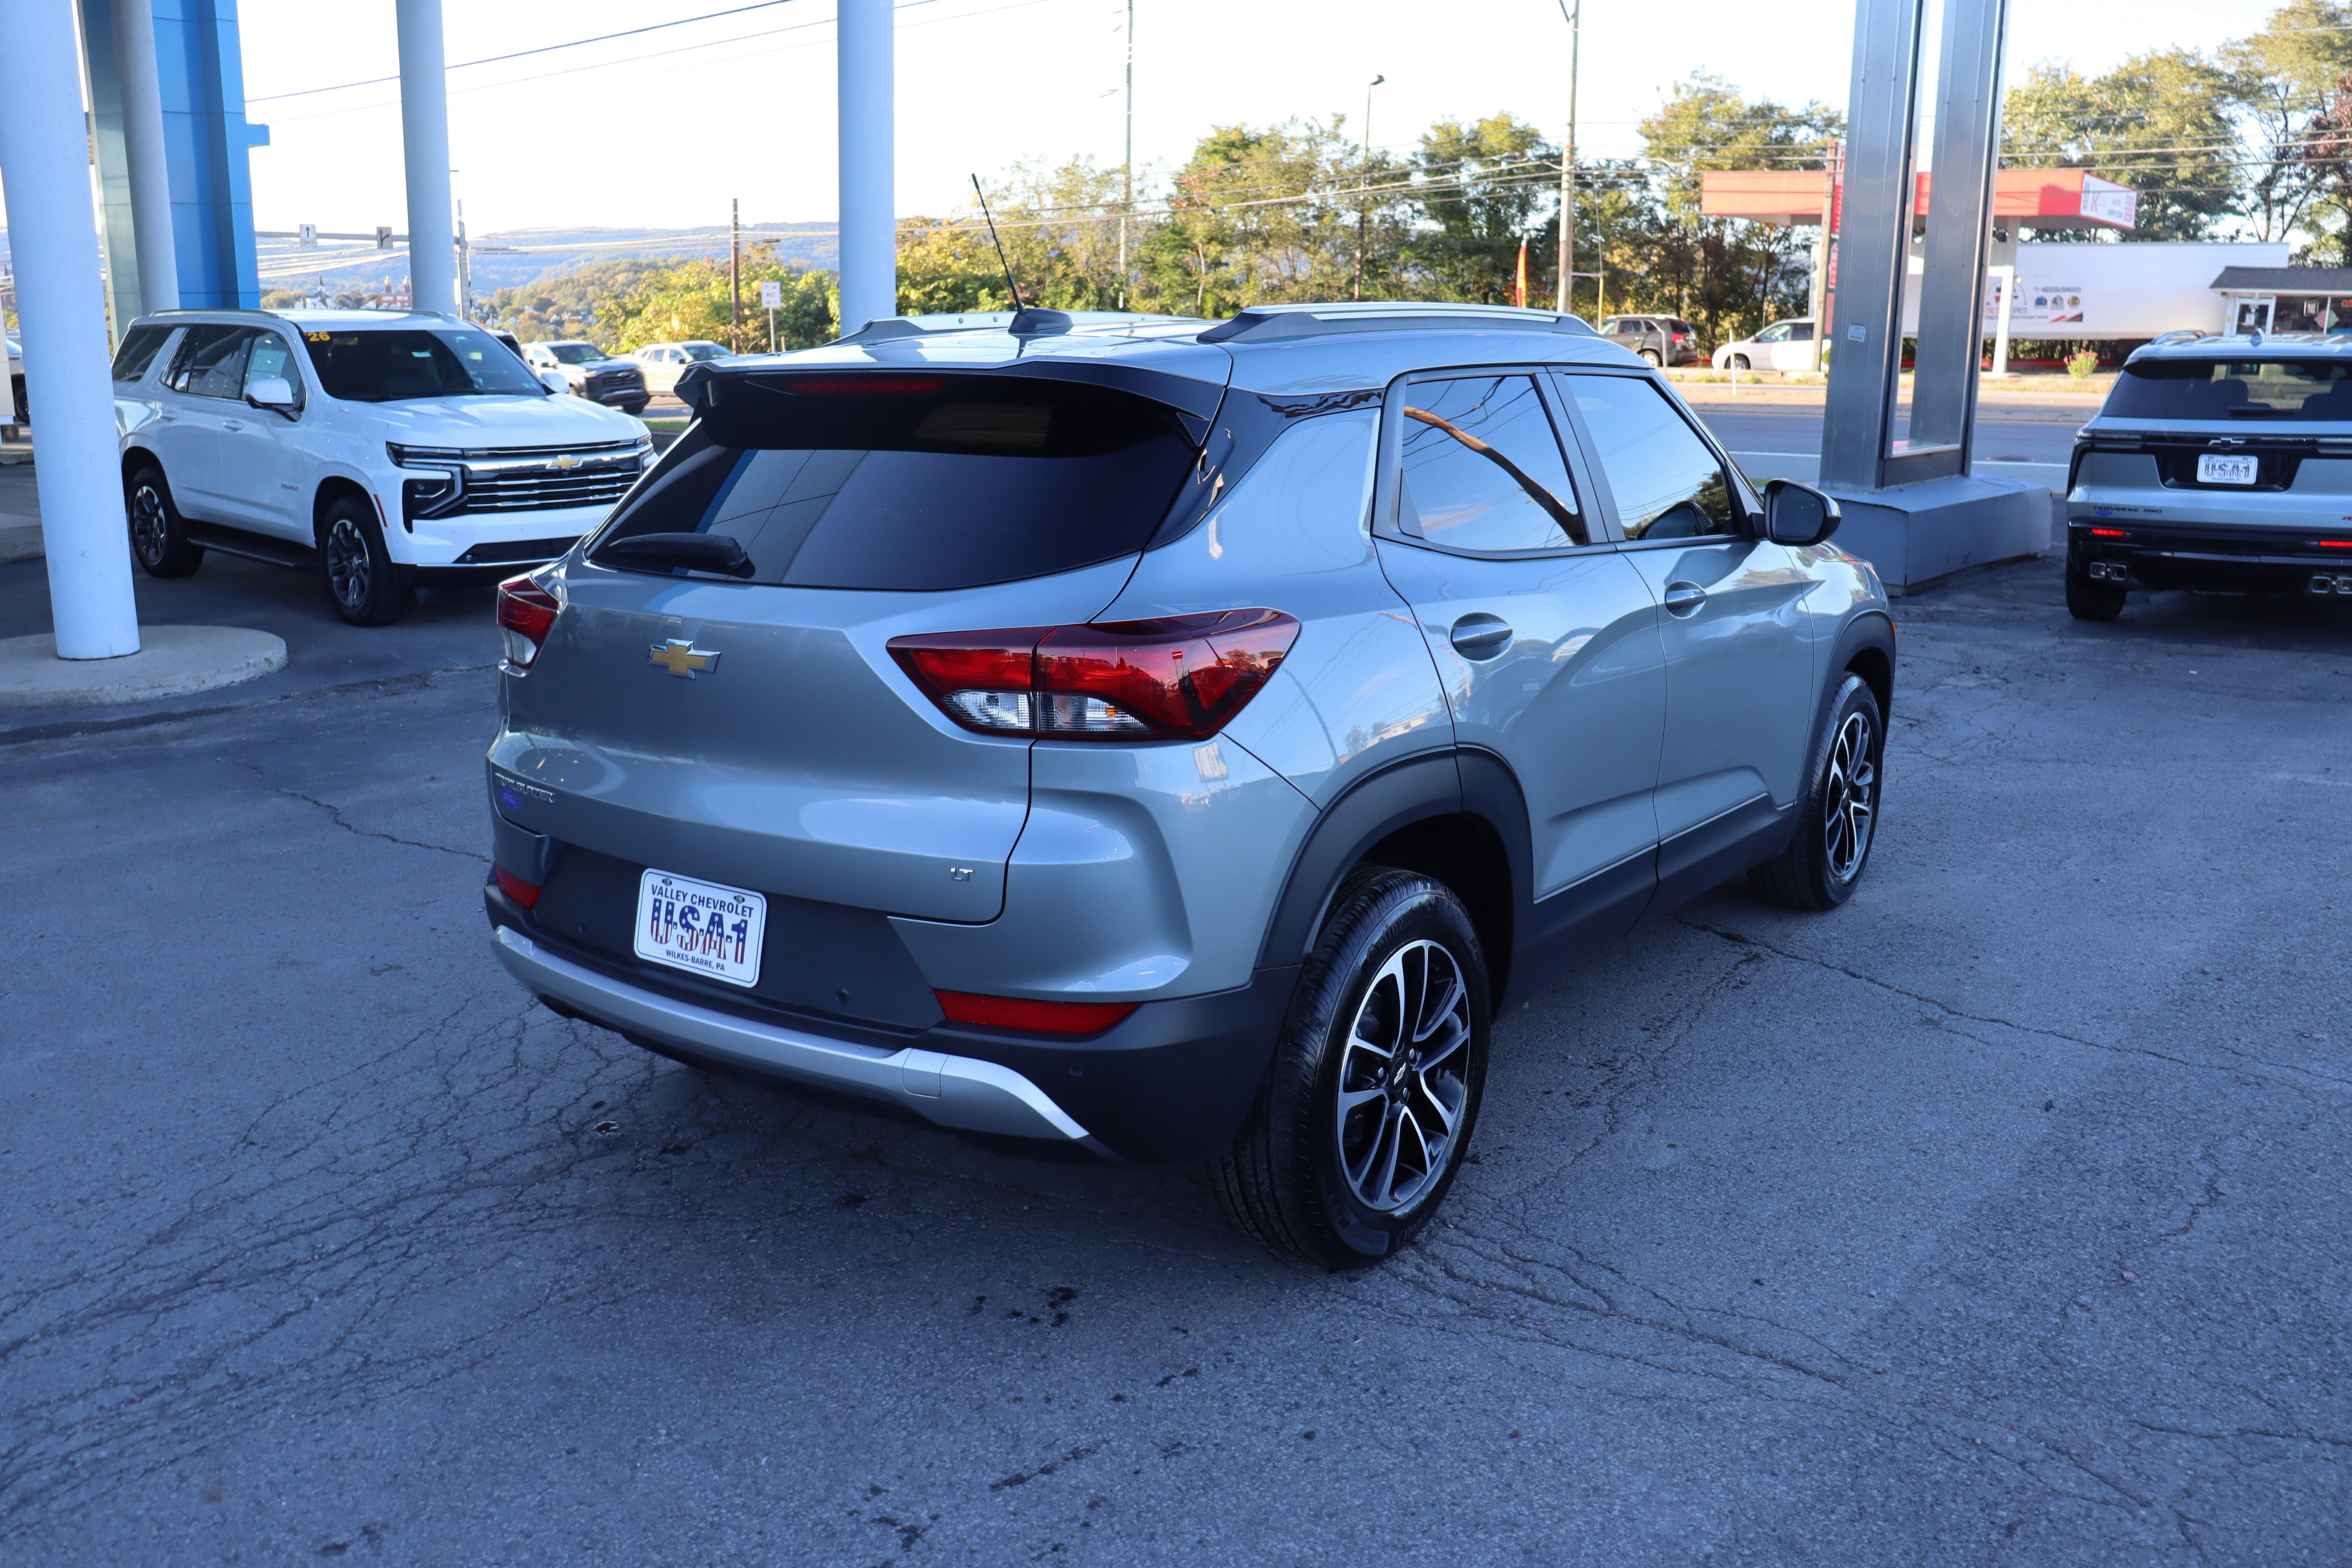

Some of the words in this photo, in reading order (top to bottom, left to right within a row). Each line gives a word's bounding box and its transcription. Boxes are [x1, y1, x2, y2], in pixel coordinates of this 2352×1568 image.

[950, 867, 974, 882] LT
[652, 884, 688, 902] VALLEY
[690, 893, 754, 918] CHEVROLET
[716, 962, 725, 971] PA
